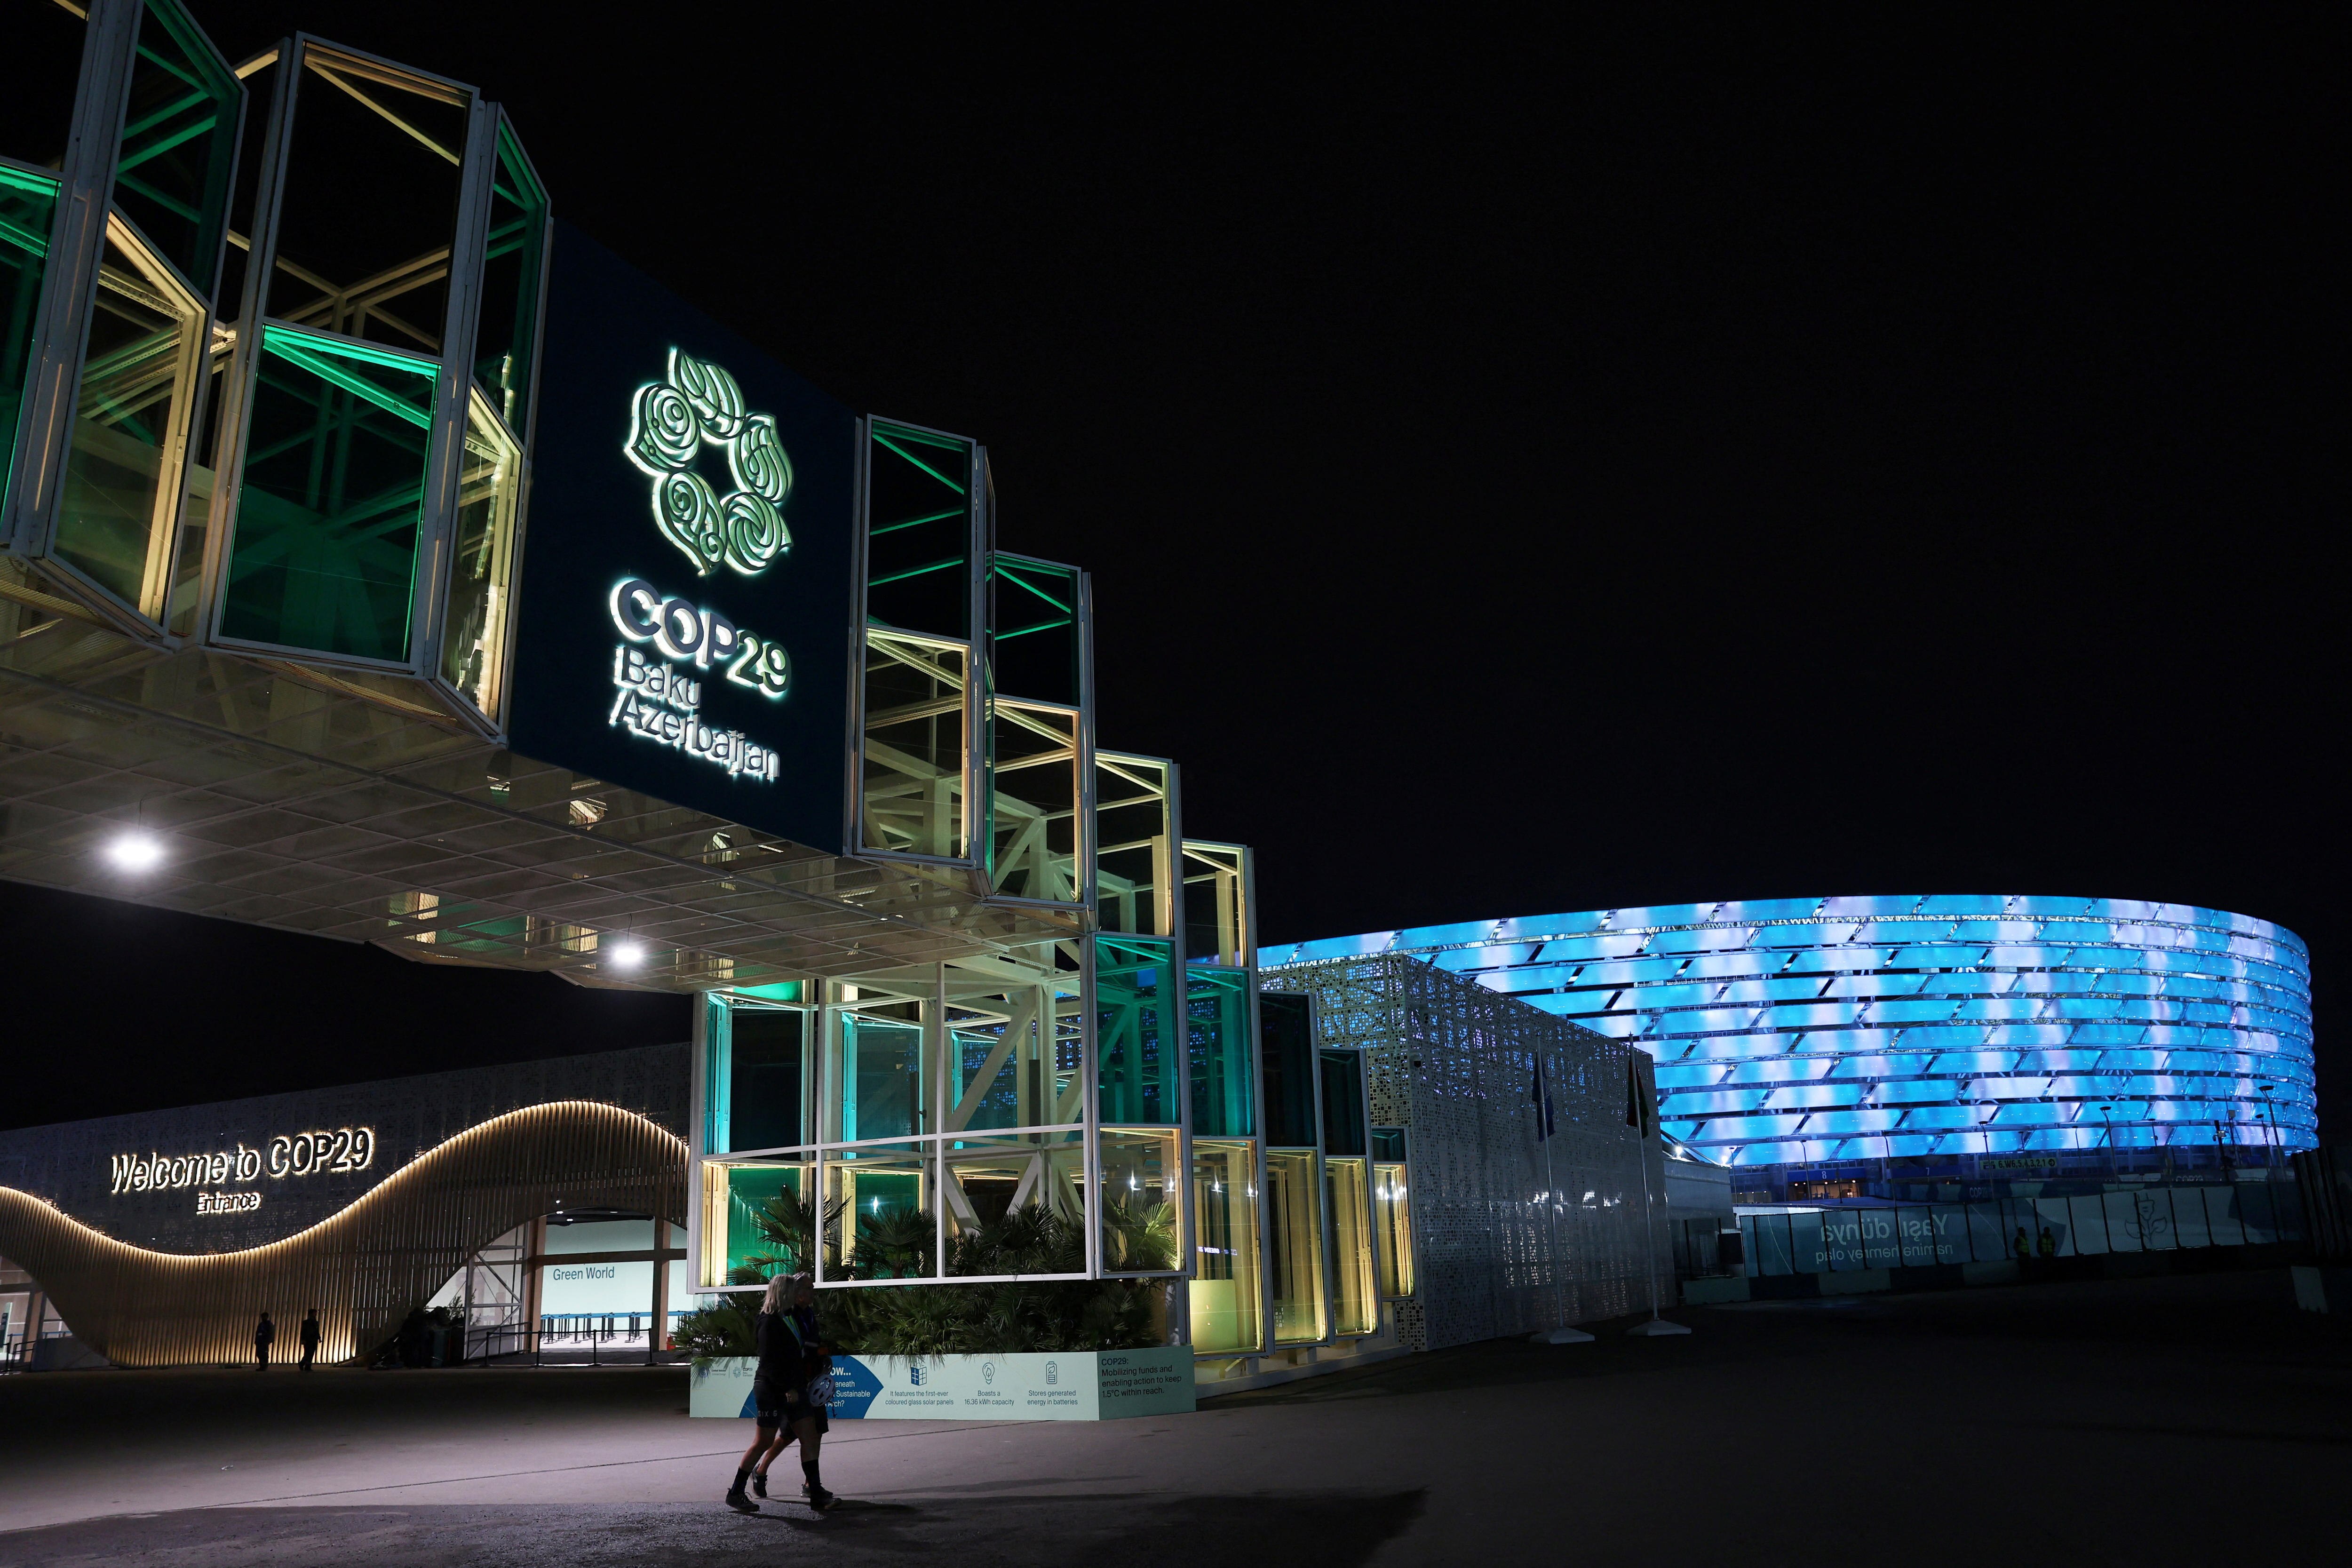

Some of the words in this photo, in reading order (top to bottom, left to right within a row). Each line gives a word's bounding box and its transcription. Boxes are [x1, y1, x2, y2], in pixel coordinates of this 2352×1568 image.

[612, 578, 791, 694] COP29
[615, 646, 701, 709] Baku
[611, 690, 780, 778] Azerbaijan
[111, 1152, 228, 1193] Welcome
[236, 1145, 260, 1181] to
[269, 1128, 374, 1178] COP29
[196, 1191, 261, 1214] Entrance
[553, 1269, 583, 1280] Green
[586, 1266, 614, 1279] World
[1101, 1357, 1128, 1366] COP29:
[1102, 1368, 1137, 1377] Mobilizing
